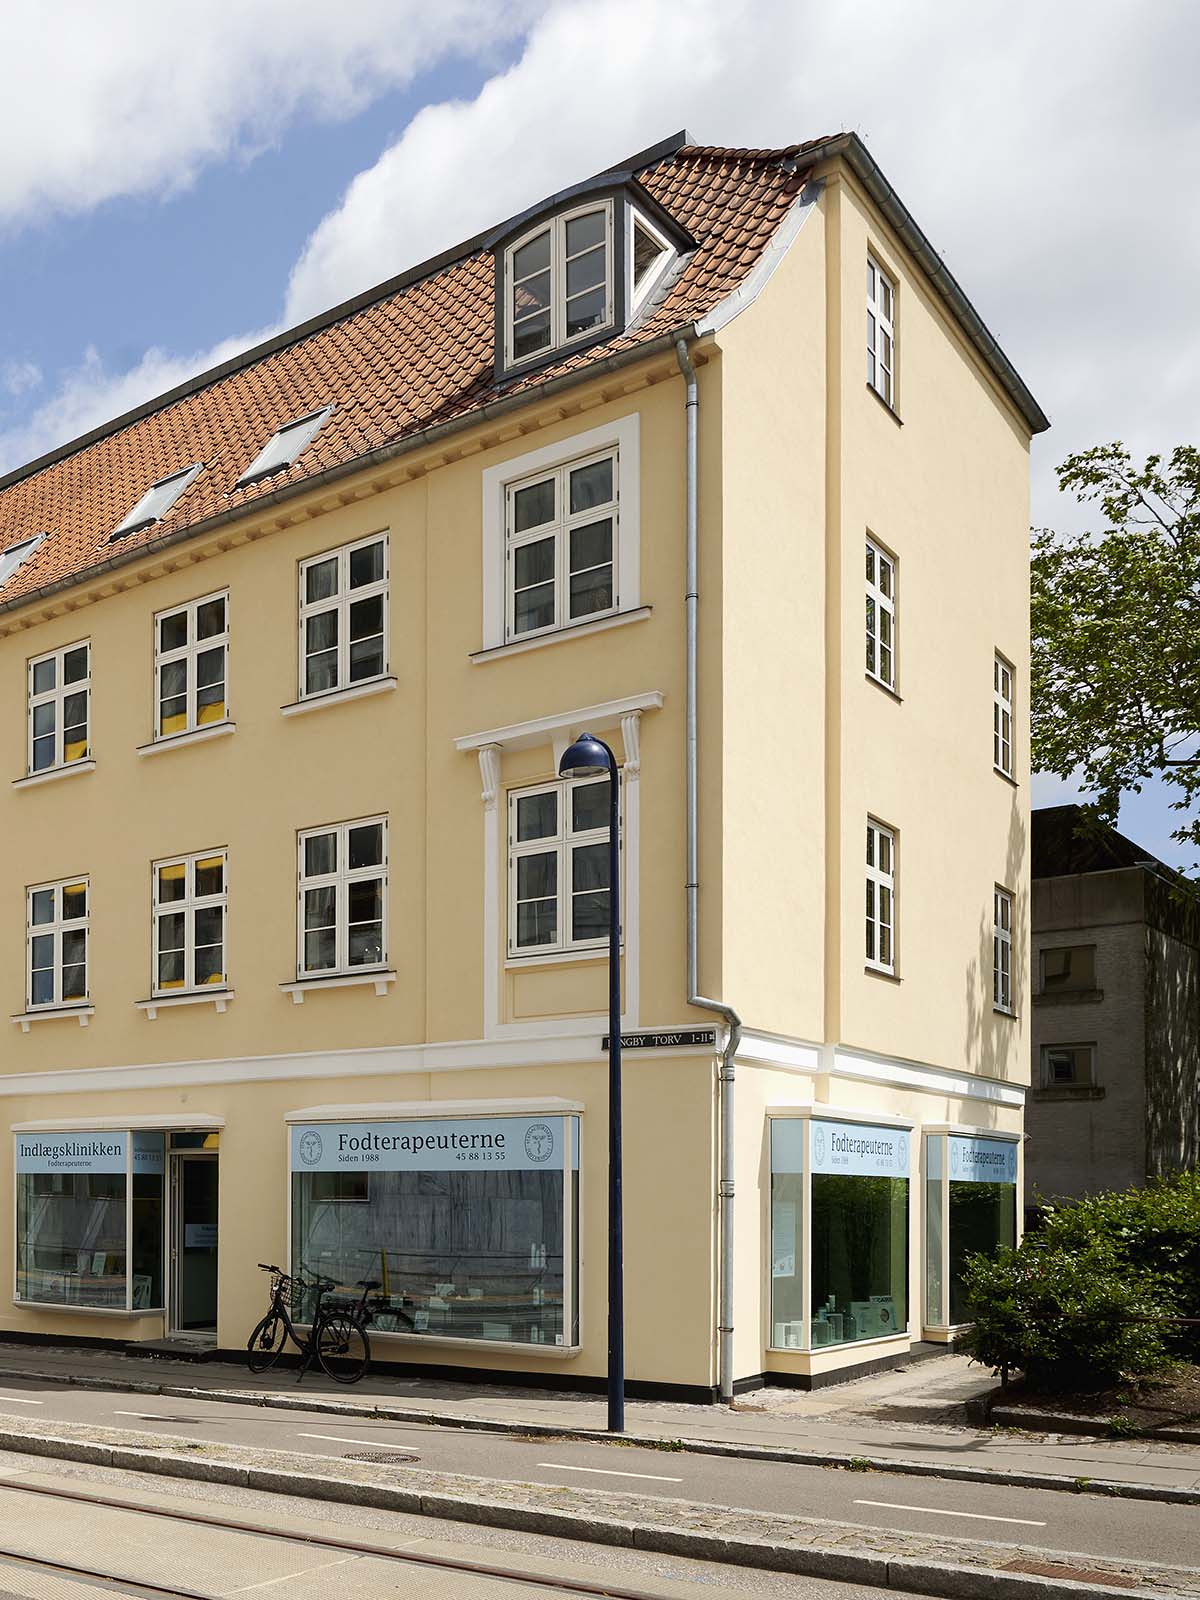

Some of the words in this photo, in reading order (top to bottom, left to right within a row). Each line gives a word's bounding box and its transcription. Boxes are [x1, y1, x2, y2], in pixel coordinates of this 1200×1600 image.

[607, 1037, 646, 1047] NGBY
[652, 1035, 682, 1045] TORV
[691, 1033, 708, 1043] 1-11
[338, 1132, 506, 1153] Fodterapeuterne
[831, 1132, 893, 1158] Fodterapeuterne
[20, 1142, 122, 1159] Indlægsklinikken
[338, 1153, 359, 1162] Siden
[361, 1153, 380, 1162] 1988
[455, 1152, 467, 1161] 45
[469, 1152, 480, 1160] 88
[482, 1152, 492, 1160] 13
[494, 1151, 506, 1160] 55
[962, 1146, 1006, 1167] Fodterapeuterne
[47, 1160, 92, 1168] Fodterapeuterne
